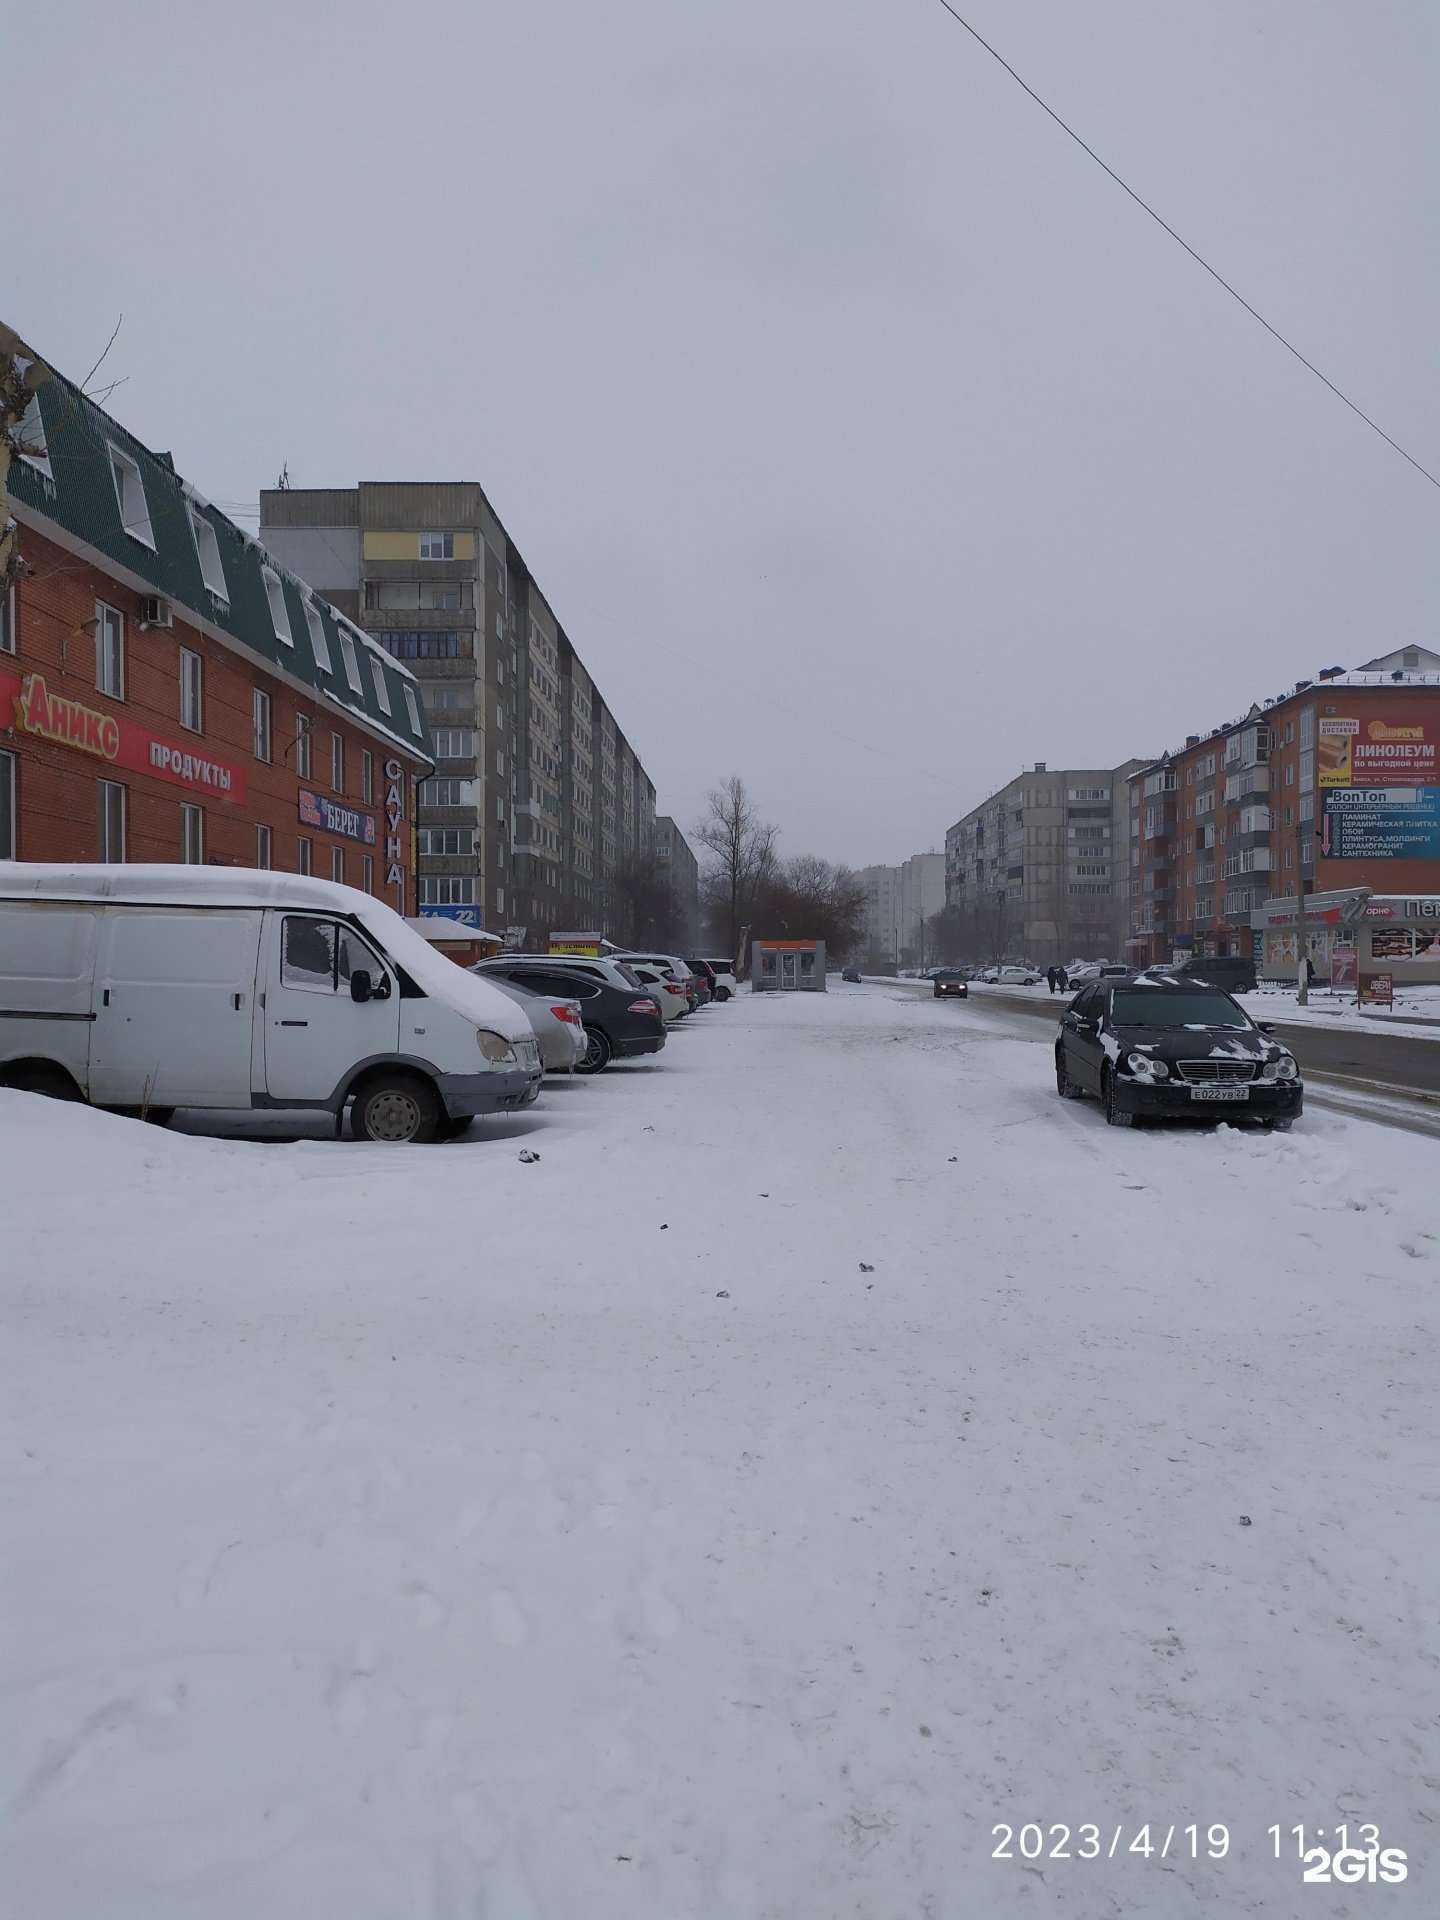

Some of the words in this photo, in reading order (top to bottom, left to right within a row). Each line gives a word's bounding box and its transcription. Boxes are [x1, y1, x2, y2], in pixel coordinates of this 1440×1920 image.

[151, 742, 232, 790] ПРОДУКТЫ
[1355, 745, 1435, 757] ЛИНОЛЕУМ
[385, 759, 401, 885] САУНА
